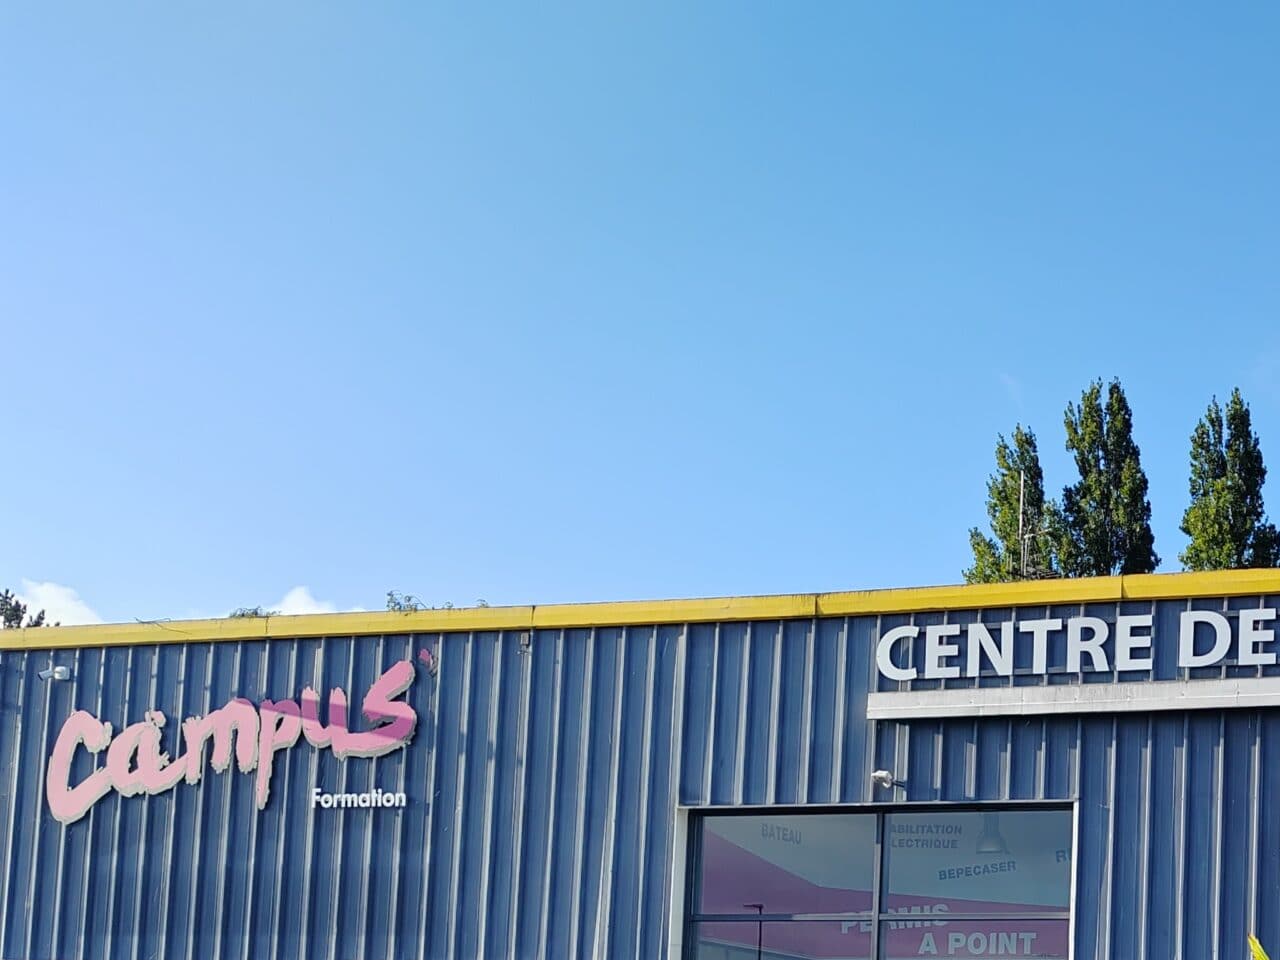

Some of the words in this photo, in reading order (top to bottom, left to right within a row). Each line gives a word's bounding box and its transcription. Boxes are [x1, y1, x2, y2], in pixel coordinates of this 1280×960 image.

[876, 613, 1154, 682] CENTRE
[1178, 607, 1277, 668] DE
[310, 786, 407, 809] Formation
[761, 823, 802, 845] BATEAU
[891, 824, 963, 835] ABILITATION
[891, 838, 961, 849] LECTRIQUE
[938, 860, 1017, 880] BEPECASER
[918, 932, 938, 956] A
[948, 932, 1037, 955] POINT
